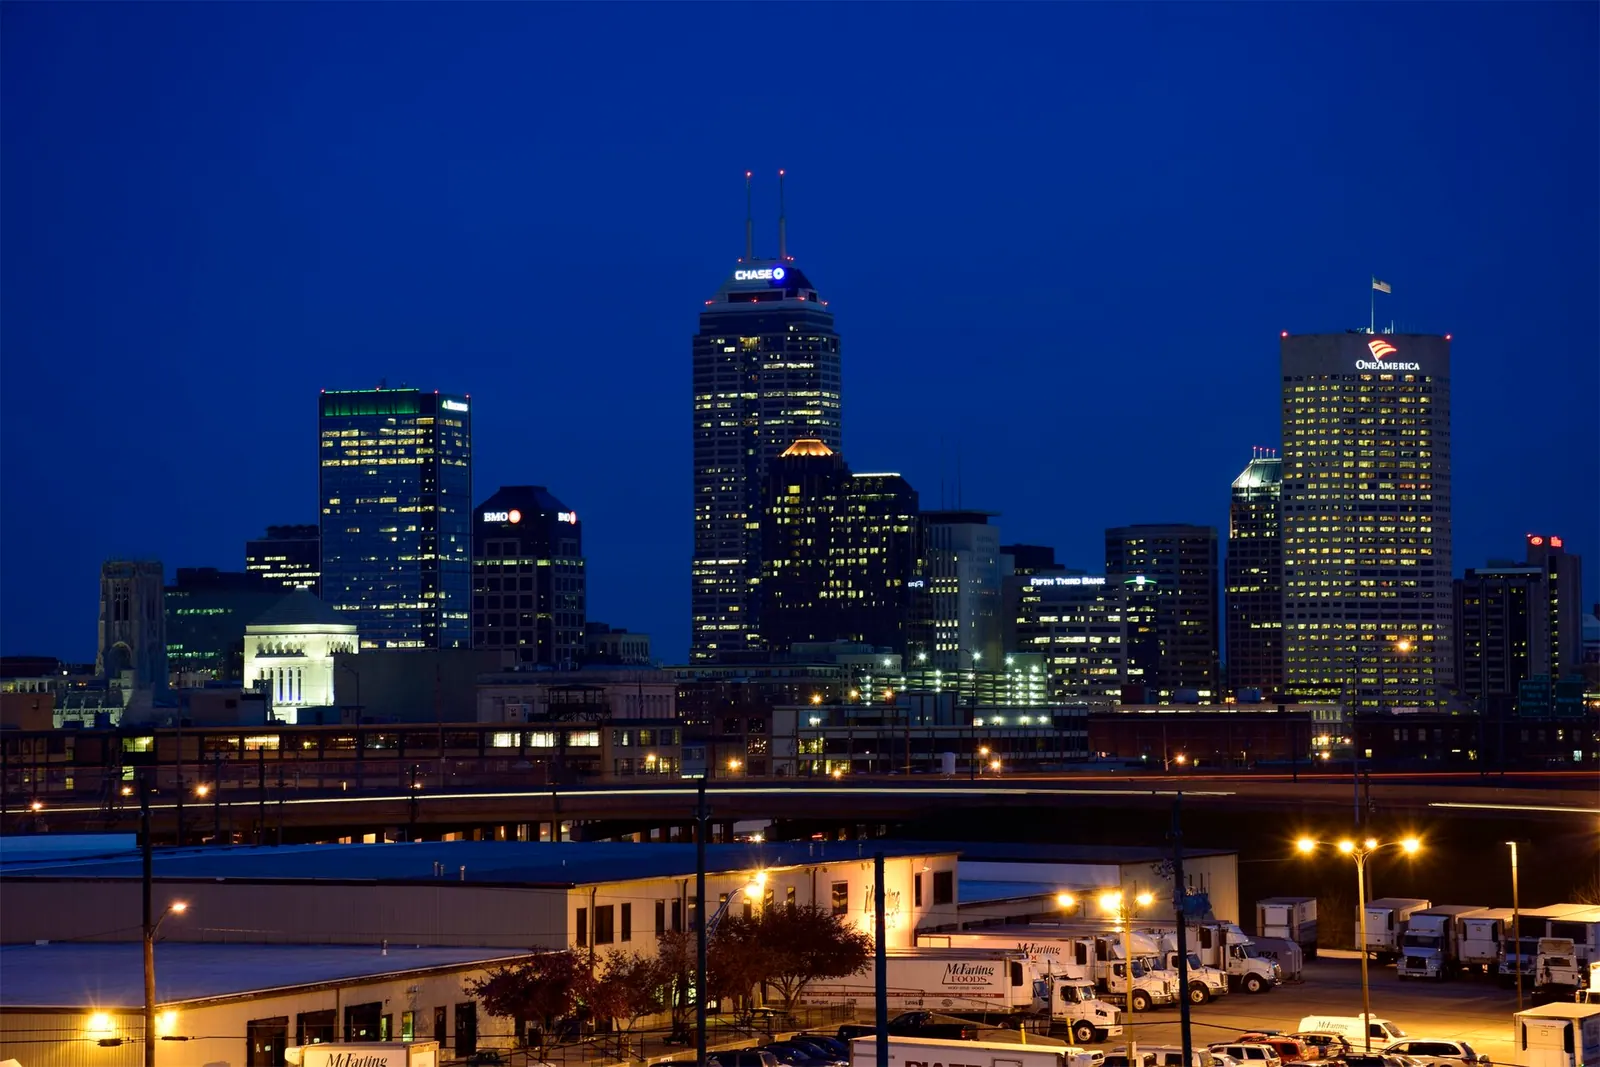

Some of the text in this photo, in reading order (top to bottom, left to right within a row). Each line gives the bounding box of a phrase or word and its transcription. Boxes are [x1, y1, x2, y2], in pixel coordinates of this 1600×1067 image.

[735, 269, 773, 280] CHASE
[483, 512, 509, 522] BMO
[1030, 576, 1106, 586] FIFTH THIRD BANK
[946, 962, 994, 976] McFarling
[951, 975, 987, 983] FOODS
